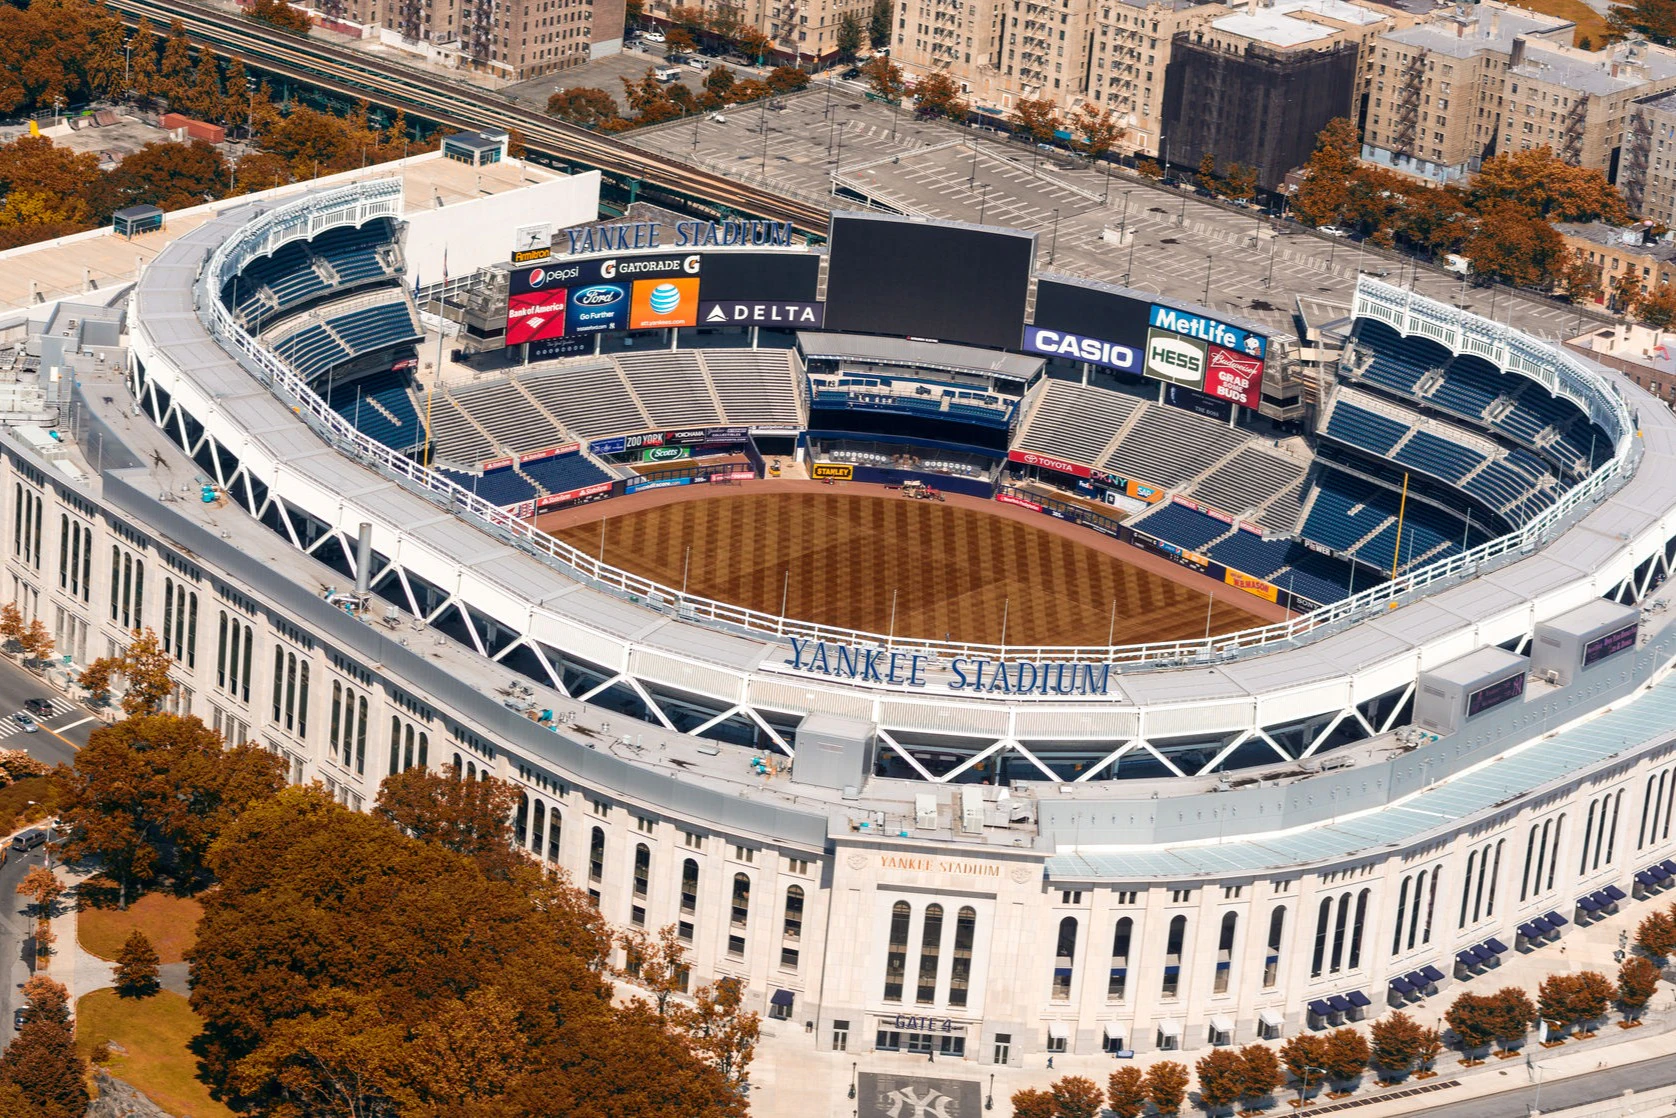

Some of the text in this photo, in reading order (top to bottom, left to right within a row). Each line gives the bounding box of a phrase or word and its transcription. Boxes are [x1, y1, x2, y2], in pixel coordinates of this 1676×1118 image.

[564, 219, 794, 255] YANKEE STADIUM
[515, 249, 550, 262] Armitron
[546, 266, 579, 282] pepsi
[619, 260, 680, 273] GATORADE
[583, 288, 613, 304] Ford
[509, 303, 564, 318] Bank of America
[590, 311, 615, 319] Further
[734, 304, 815, 322] DELTA
[1156, 308, 1236, 347] MetLife
[1035, 330, 1133, 368] CASIO
[1152, 346, 1200, 372] HESS
[1211, 352, 1257, 375] Budweiser
[1218, 371, 1249, 389] GRAB
[1222, 381, 1244, 393] SOME
[1217, 385, 1247, 403] BUDS
[626, 435, 642, 448] ZOO
[642, 432, 663, 446] YORK
[674, 430, 704, 438] YOKOHAMA
[654, 448, 678, 457] Scotts
[816, 467, 851, 477] STANLEY
[1038, 458, 1073, 472] TOYOTA
[1079, 480, 1093, 490] FedEx
[1091, 470, 1127, 487] DKNY
[1137, 486, 1152, 497] SAP
[1296, 597, 1319, 610] SONY
[788, 637, 1112, 696] YANKEE STADIUM
[881, 855, 1000, 877] YANKEE STADIUM
[895, 1014, 952, 1033] GATE 4
